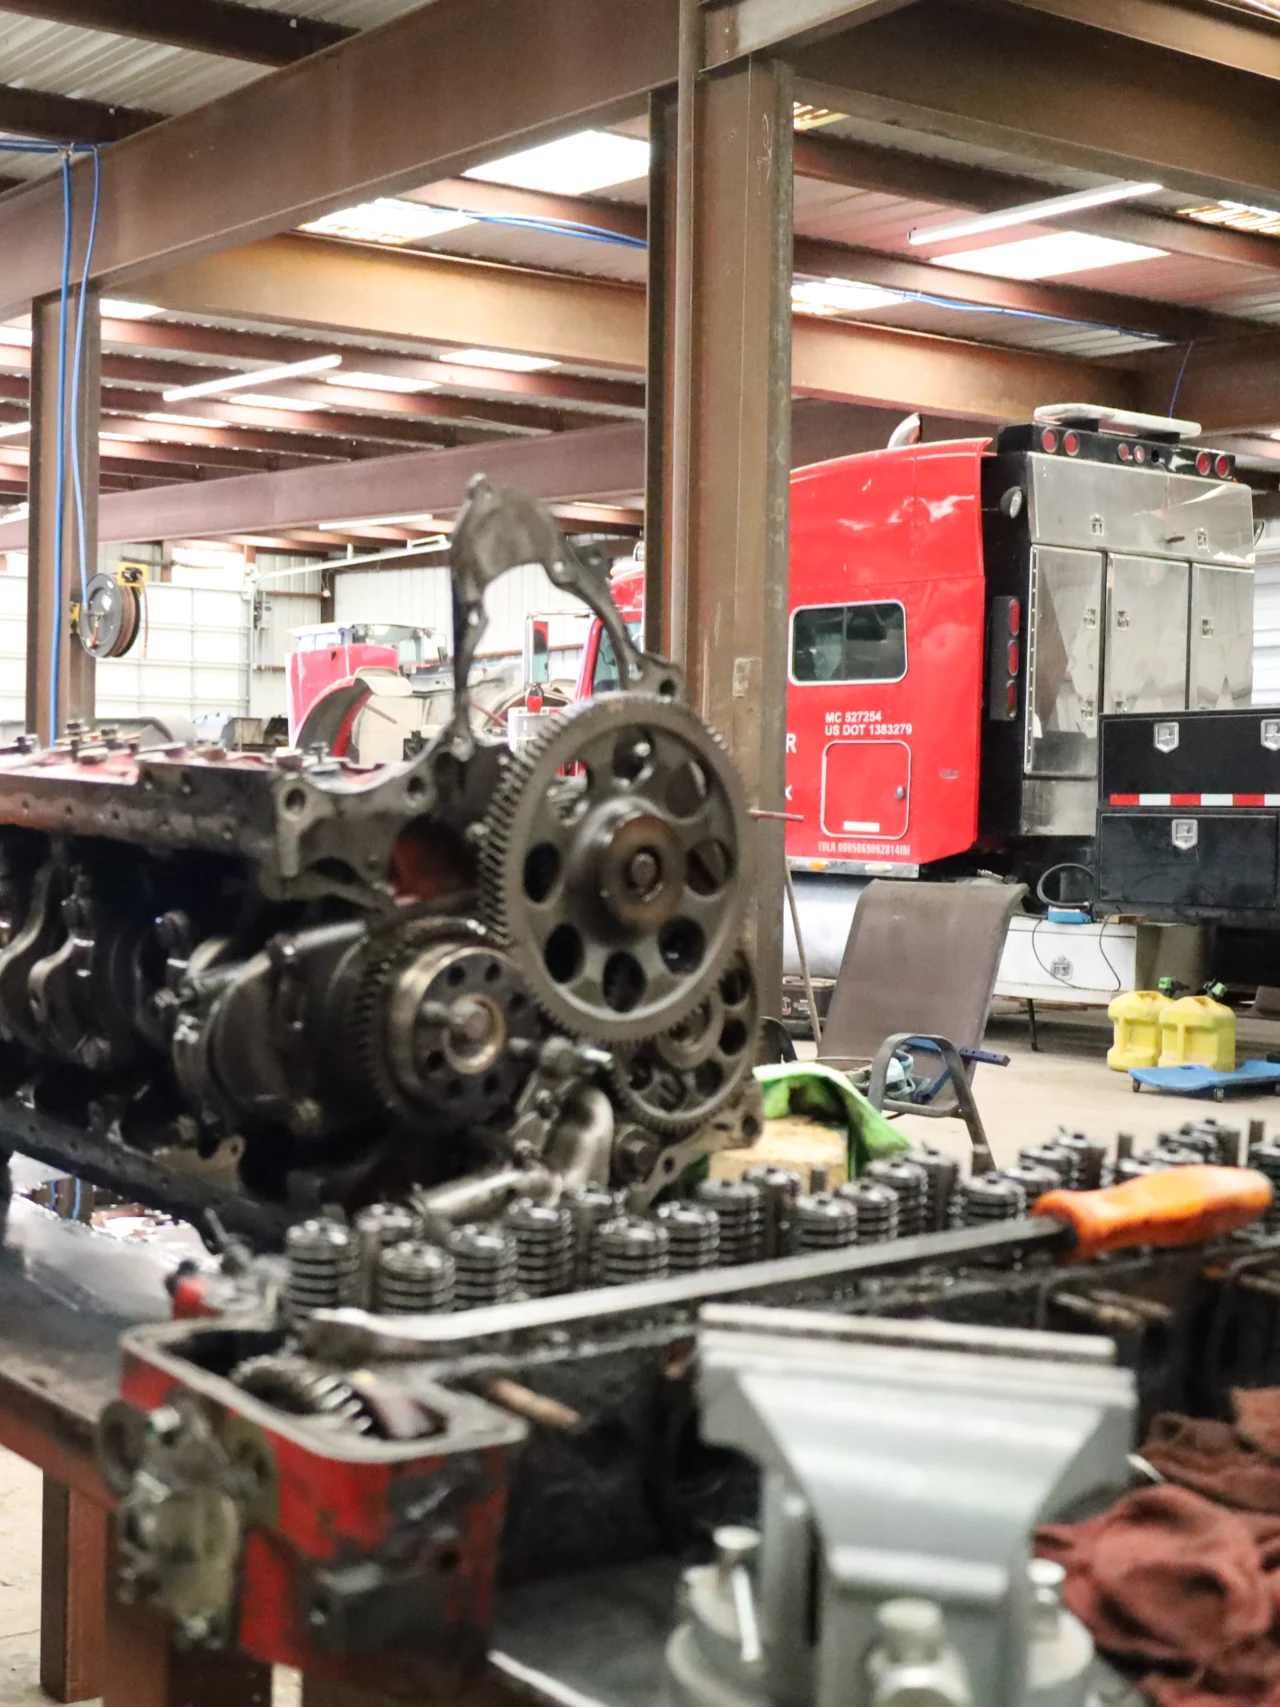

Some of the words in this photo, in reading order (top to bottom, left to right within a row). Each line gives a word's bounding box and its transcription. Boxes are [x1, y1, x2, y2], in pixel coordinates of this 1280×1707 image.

[825, 712, 842, 723] MC
[845, 711, 882, 722] 527254
[825, 725, 840, 736] US
[842, 724, 866, 736] DOT
[869, 723, 912, 735] 1383279
